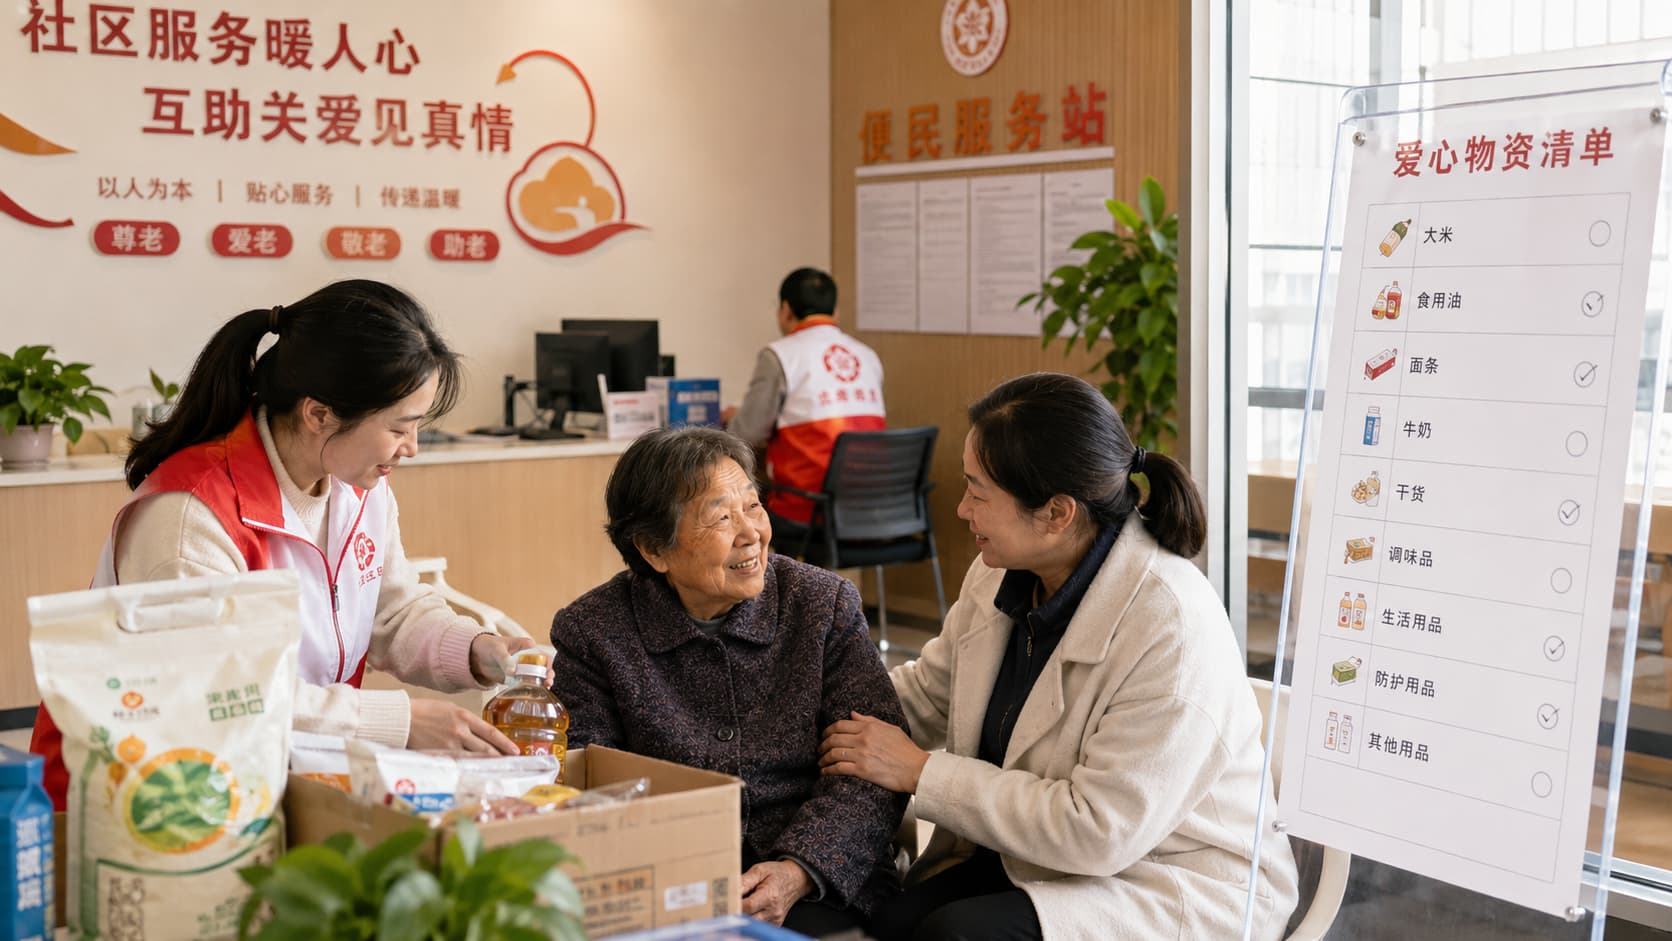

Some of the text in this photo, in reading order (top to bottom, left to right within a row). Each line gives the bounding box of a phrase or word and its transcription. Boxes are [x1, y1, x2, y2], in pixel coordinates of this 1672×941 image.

[20, 0, 421, 76] 社区服务暖人心
[141, 86, 515, 153] 互助关爱见真情
[859, 82, 1106, 163] 便民服务站
[1393, 126, 1614, 178] 爱心物资清单
[98, 177, 460, 209] 以人为本 贴心服务 传递温暖
[111, 225, 164, 252] 尊老
[227, 229, 277, 254] 爱老
[341, 233, 387, 257] 敬老
[443, 234, 487, 258] 助老
[1424, 226, 1453, 244] 大米
[1417, 292, 1462, 310] 食用油
[1409, 357, 1439, 375] 面条
[1403, 421, 1432, 439] 牛奶
[1396, 484, 1426, 503] 干货
[1389, 545, 1433, 568] 调味品
[1381, 608, 1442, 634] 生活用品
[1375, 670, 1435, 698] 防护用品
[1368, 732, 1429, 762] 其他用品
